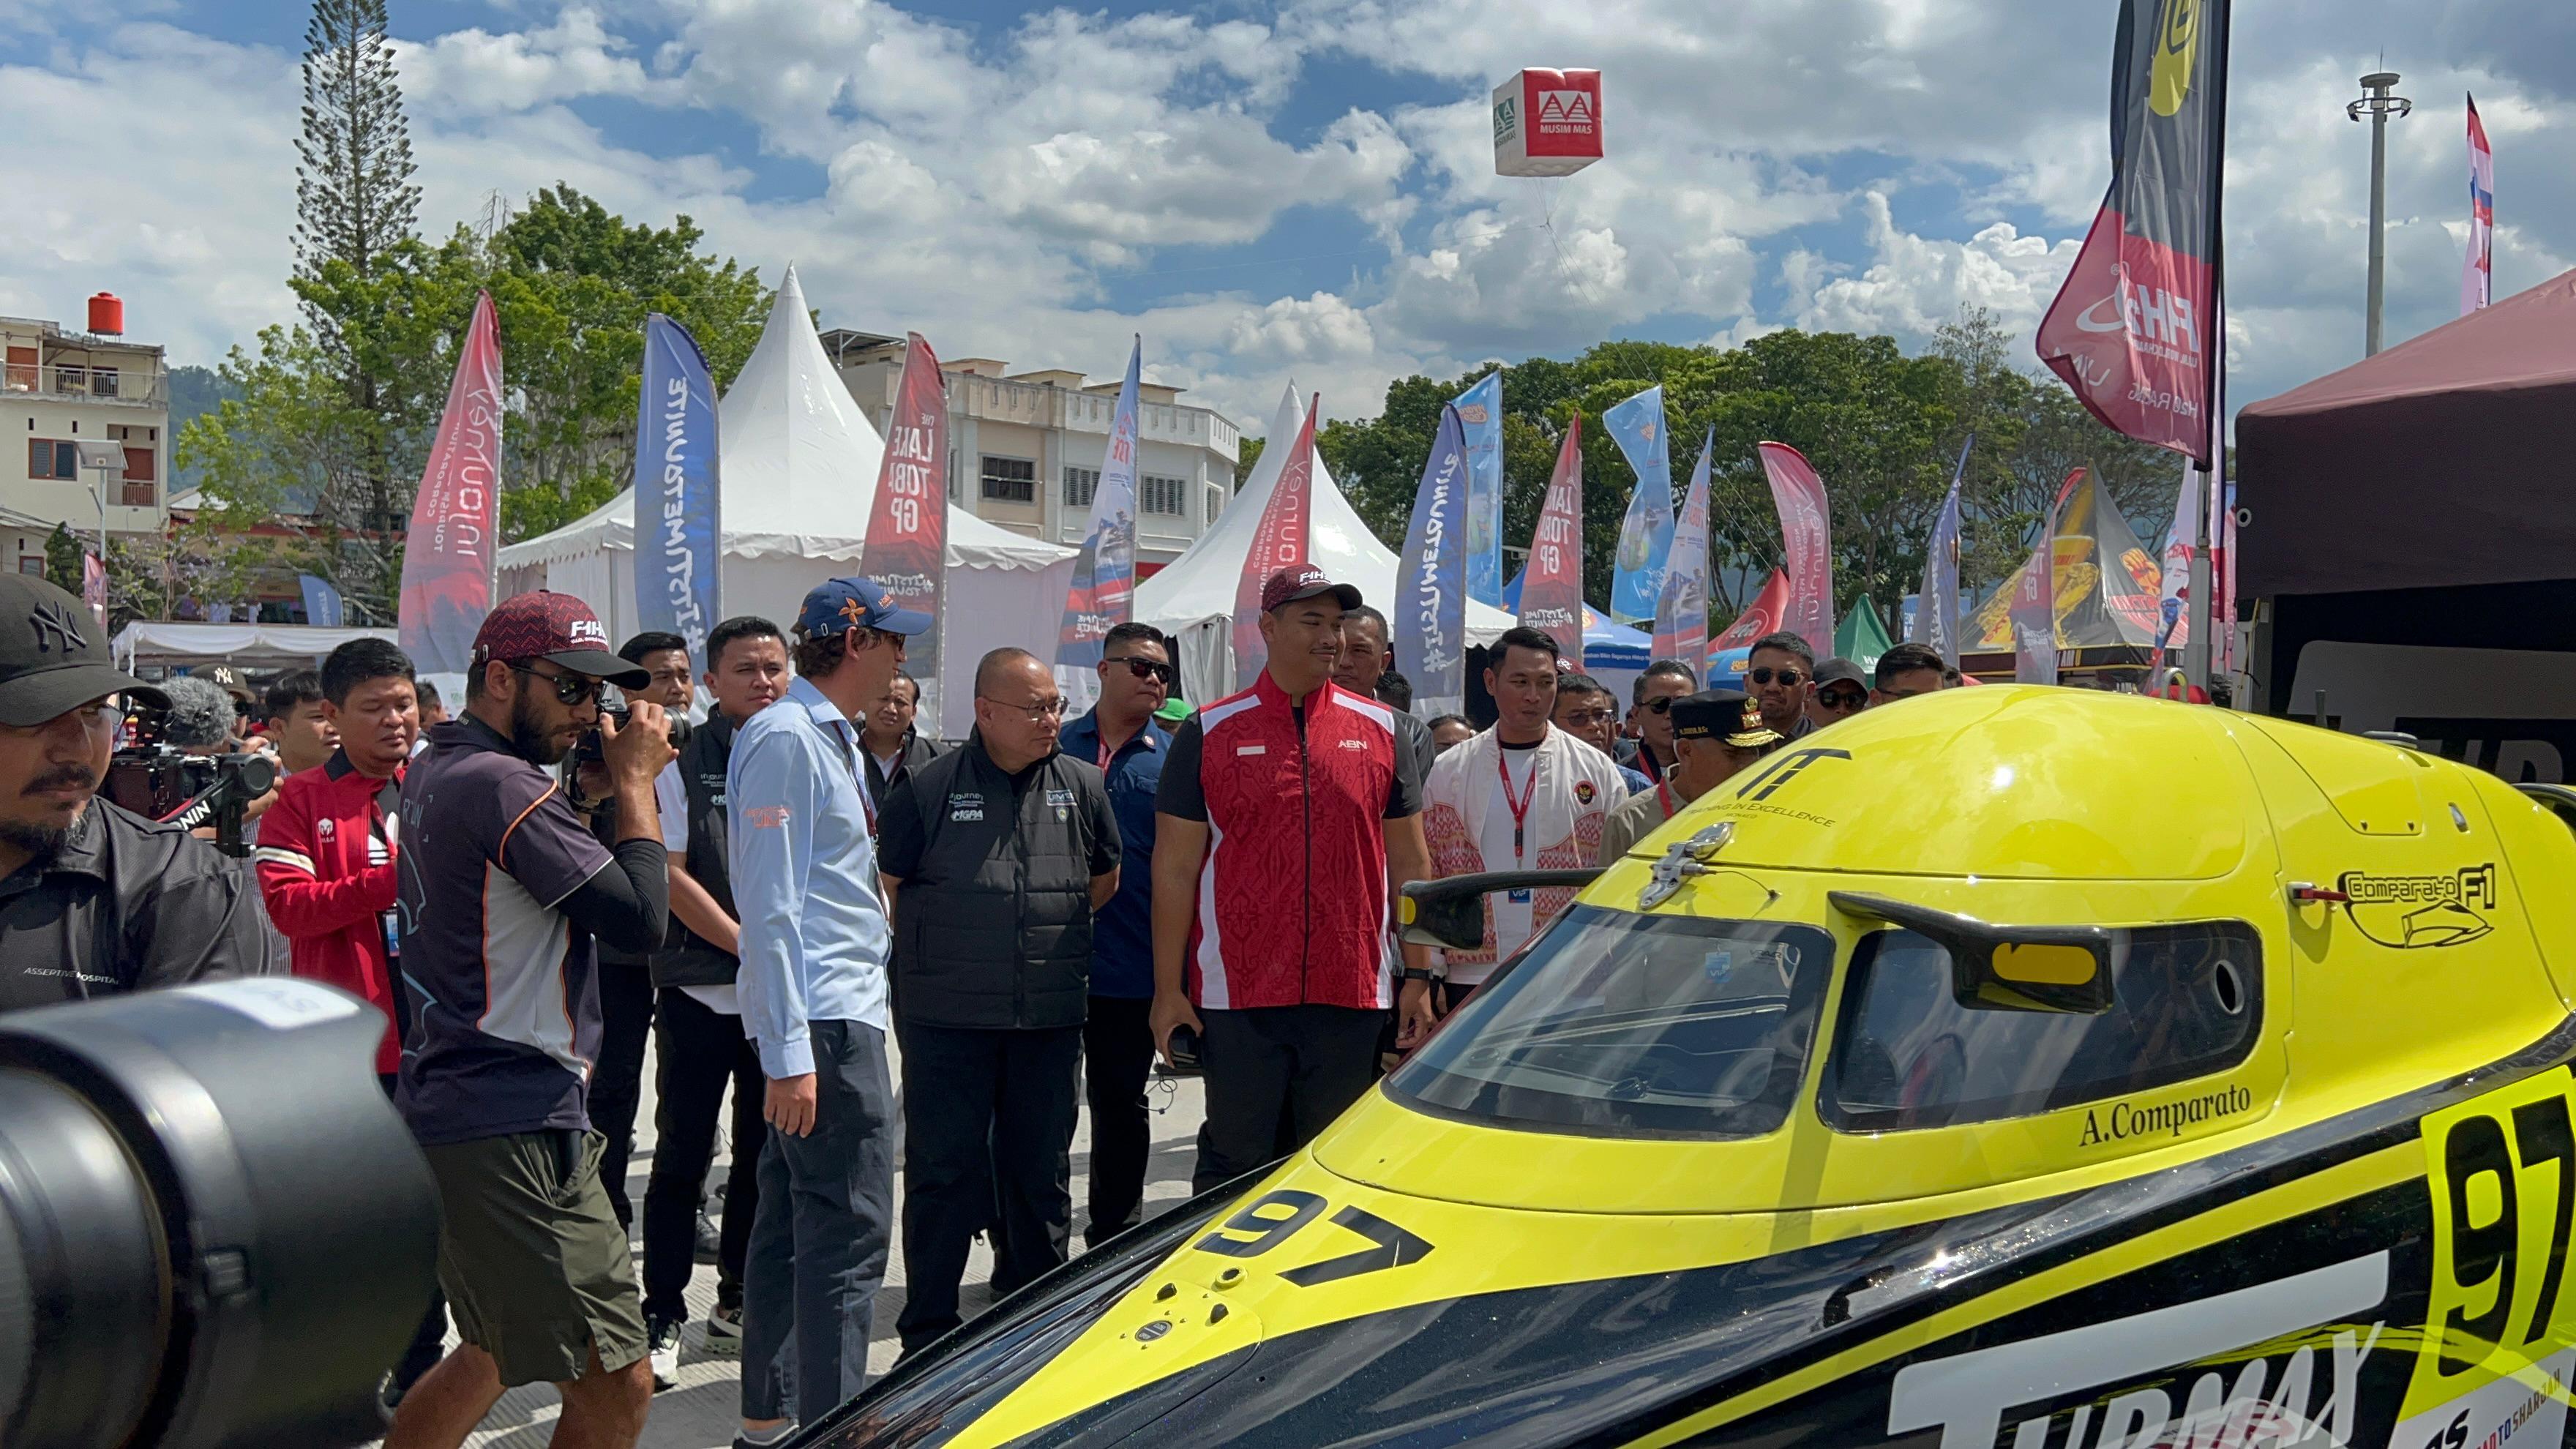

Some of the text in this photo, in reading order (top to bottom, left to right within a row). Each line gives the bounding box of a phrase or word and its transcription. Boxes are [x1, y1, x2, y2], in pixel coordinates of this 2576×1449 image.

[1540, 124, 1592, 134] MUSIM MAS
[29, 600, 87, 653] NY
[214, 667, 233, 684] NY
[1338, 739, 1368, 750] ABN
[951, 809, 984, 821] MGPA
[1747, 803, 1836, 828] EXCELLENCE
[2457, 863, 2496, 909] F1
[2078, 1083, 2251, 1147] A.Comparato
[1191, 1189, 1437, 1289] 97
[2437, 1093, 2576, 1377] 97
